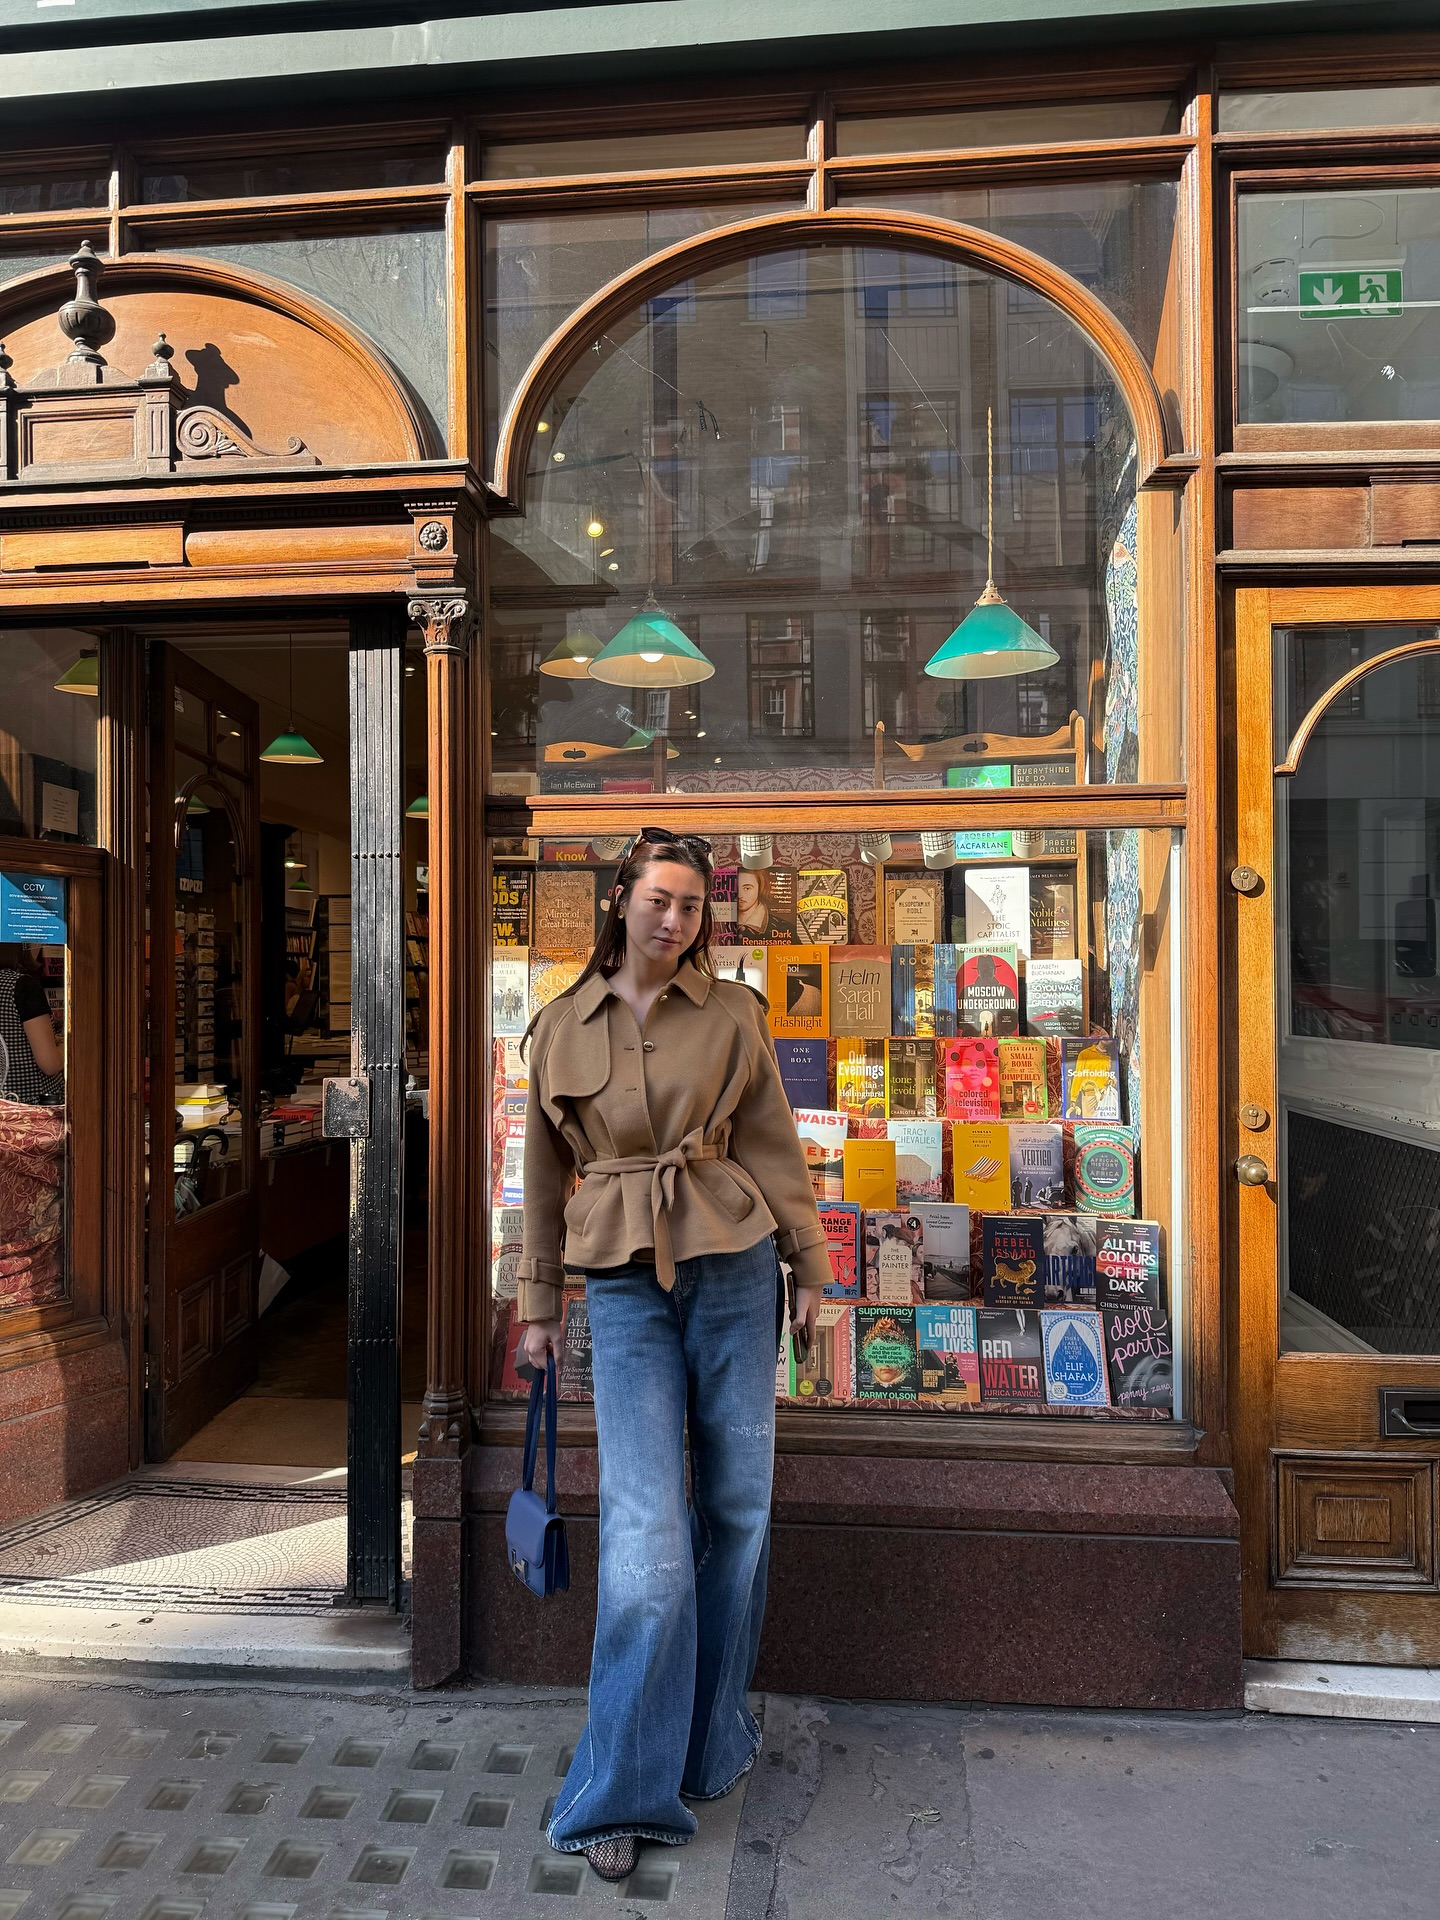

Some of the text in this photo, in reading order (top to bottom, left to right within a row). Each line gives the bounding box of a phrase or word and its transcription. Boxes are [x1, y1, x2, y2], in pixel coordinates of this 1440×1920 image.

[1017, 766, 1070, 775] EVERYTHING
[563, 781, 596, 789] McEwan
[964, 832, 996, 840] ROBERT
[1049, 846, 1076, 854] ALKER
[555, 851, 587, 861] Know
[23, 883, 45, 892] CCTV
[555, 899, 570, 909] The
[545, 909, 580, 918] Mirror of
[539, 918, 587, 928] Great Britain
[986, 922, 1010, 930] STOIC
[1031, 918, 1070, 928] Madness
[771, 929, 792, 938] Dark
[977, 930, 1020, 939] CAPITALIST
[742, 937, 792, 945] Renaissance
[775, 954, 800, 962] Susan
[779, 964, 800, 973] Choi
[839, 969, 881, 986] Helm
[967, 986, 1006, 997] MOSCOW
[1031, 984, 1079, 992] SO YOU WANT
[838, 986, 881, 1003] Sarah
[957, 998, 1016, 1010] UNDERGROUND
[846, 1003, 874, 1021] Hall
[773, 1016, 822, 1031] Flashlight
[848, 1050, 866, 1064] Our
[1010, 1052, 1034, 1060] SMALL
[838, 1062, 884, 1079] Evenings
[1067, 1069, 1116, 1078] Scaffolding
[1001, 1073, 1042, 1081] DIMPERLEY
[859, 1080, 877, 1089] Alan
[839, 1089, 884, 1098] Hollinghurst
[958, 1089, 988, 1098] colored
[955, 1098, 993, 1107] television
[796, 1111, 847, 1126] WAIST
[902, 1127, 928, 1136] TRACY
[895, 1135, 936, 1144] CHEVALIER
[1021, 1149, 1052, 1166] VERTIGO
[994, 1237, 1032, 1248] REBEL
[1102, 1237, 1152, 1253] ALL THE
[991, 1248, 1036, 1259] ISLAND
[1098, 1250, 1157, 1267] COLOURS
[1106, 1266, 1122, 1278] OF
[1123, 1267, 1149, 1281] THE
[1109, 1279, 1145, 1294] DARK
[1099, 1301, 1153, 1312] CHRIS WHITAKER
[858, 1307, 914, 1318] supremacy
[949, 1308, 973, 1324] OUR
[928, 1322, 974, 1338] LONDON
[1110, 1309, 1168, 1342] doll
[567, 1328, 586, 1338] HIS
[943, 1339, 975, 1354] LIVES
[982, 1339, 1013, 1364] RED
[1110, 1332, 1172, 1374] parts
[1065, 1362, 1084, 1371] ELIF
[982, 1364, 1039, 1390] WATER
[1055, 1371, 1096, 1382] SHAFAK
[859, 1391, 917, 1400] PARMY OLSON
[1012, 1389, 1041, 1398] PAVIČIĆ
[1117, 1388, 1149, 1404] penny
